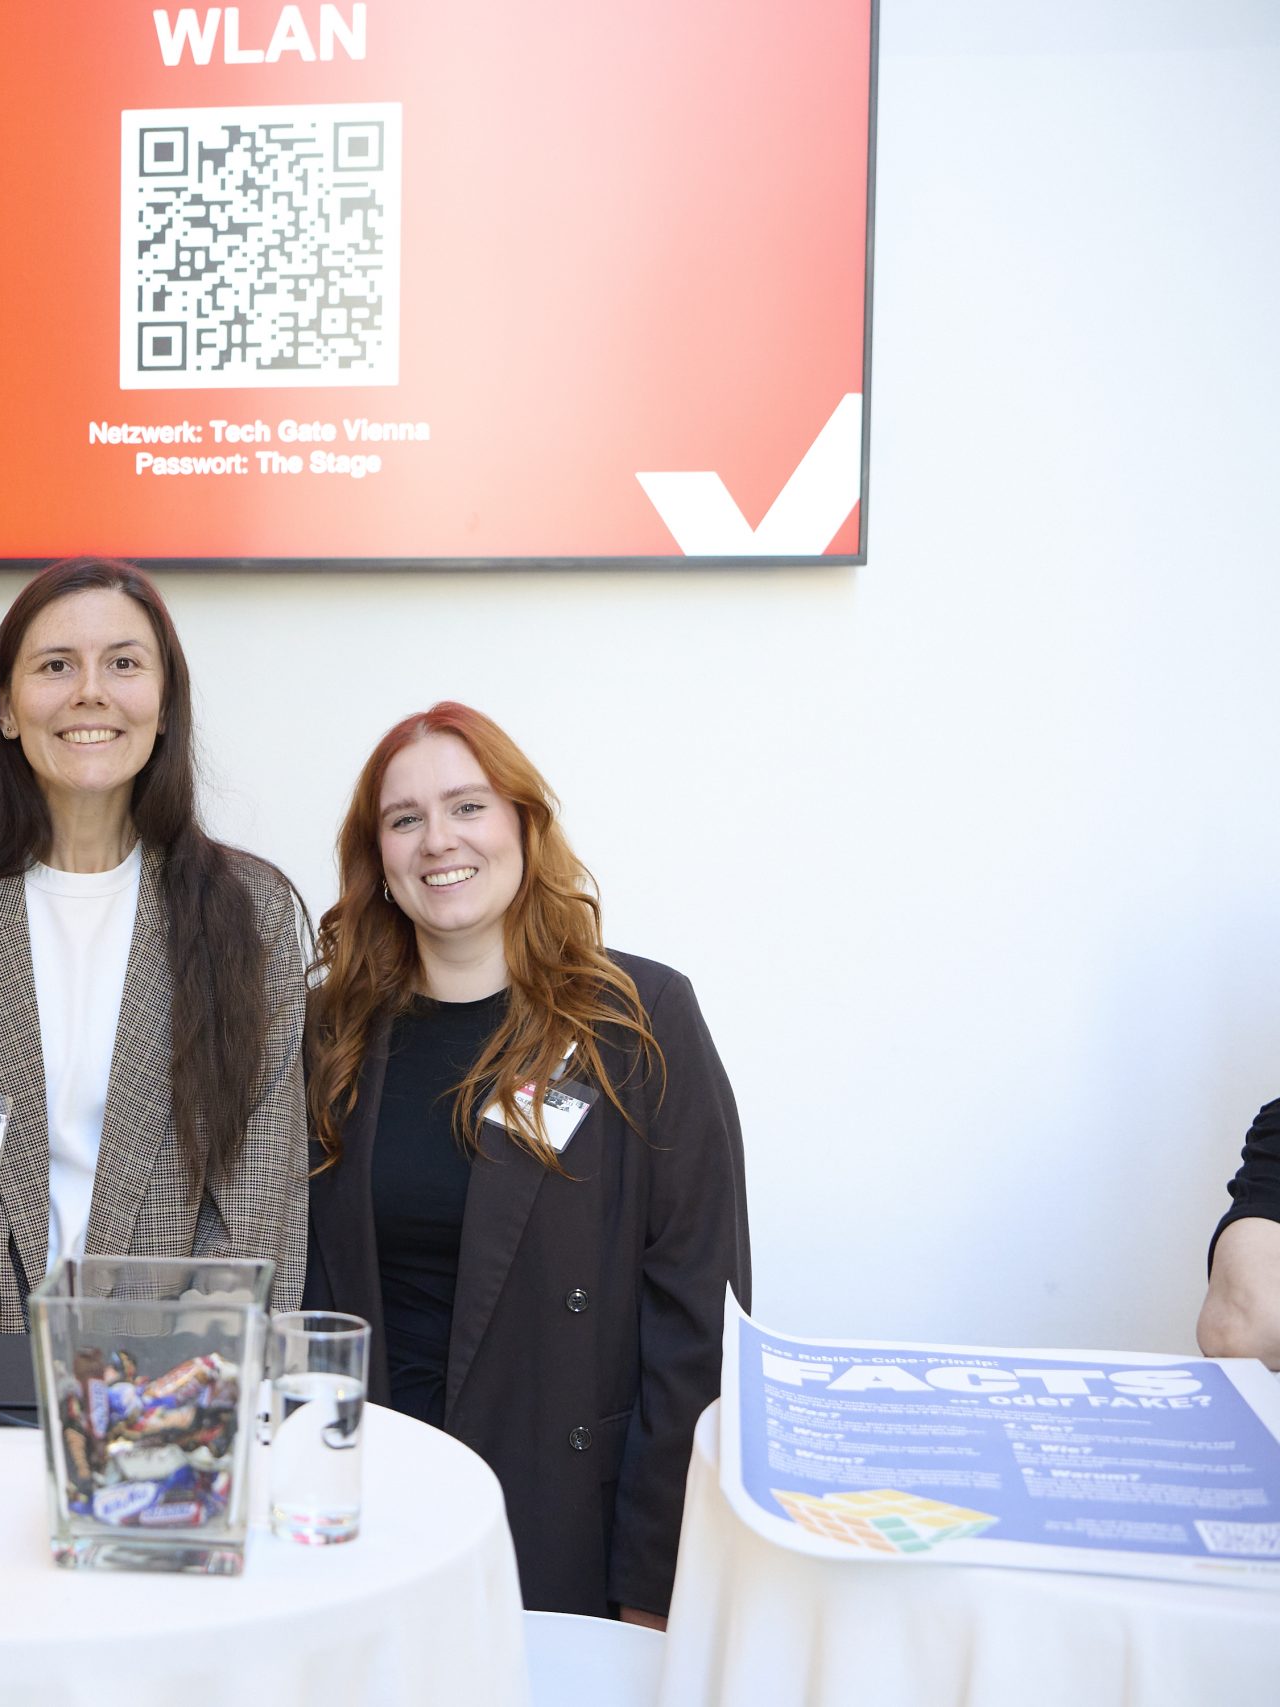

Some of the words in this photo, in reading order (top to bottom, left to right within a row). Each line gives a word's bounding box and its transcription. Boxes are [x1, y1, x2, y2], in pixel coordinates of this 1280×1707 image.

[153, 3, 367, 66] WLAN
[89, 420, 202, 444] Netzwerk:
[209, 420, 271, 443] Tech
[277, 420, 337, 442] Gate
[342, 418, 431, 441] Vienna
[135, 451, 248, 475] Passwort:
[256, 451, 303, 474] The
[309, 450, 382, 478] Stage
[761, 1343, 793, 1357] Das
[762, 1350, 1203, 1397] FACTS
[988, 1394, 1075, 1407] oder
[1087, 1395, 1213, 1409] FAKE?
